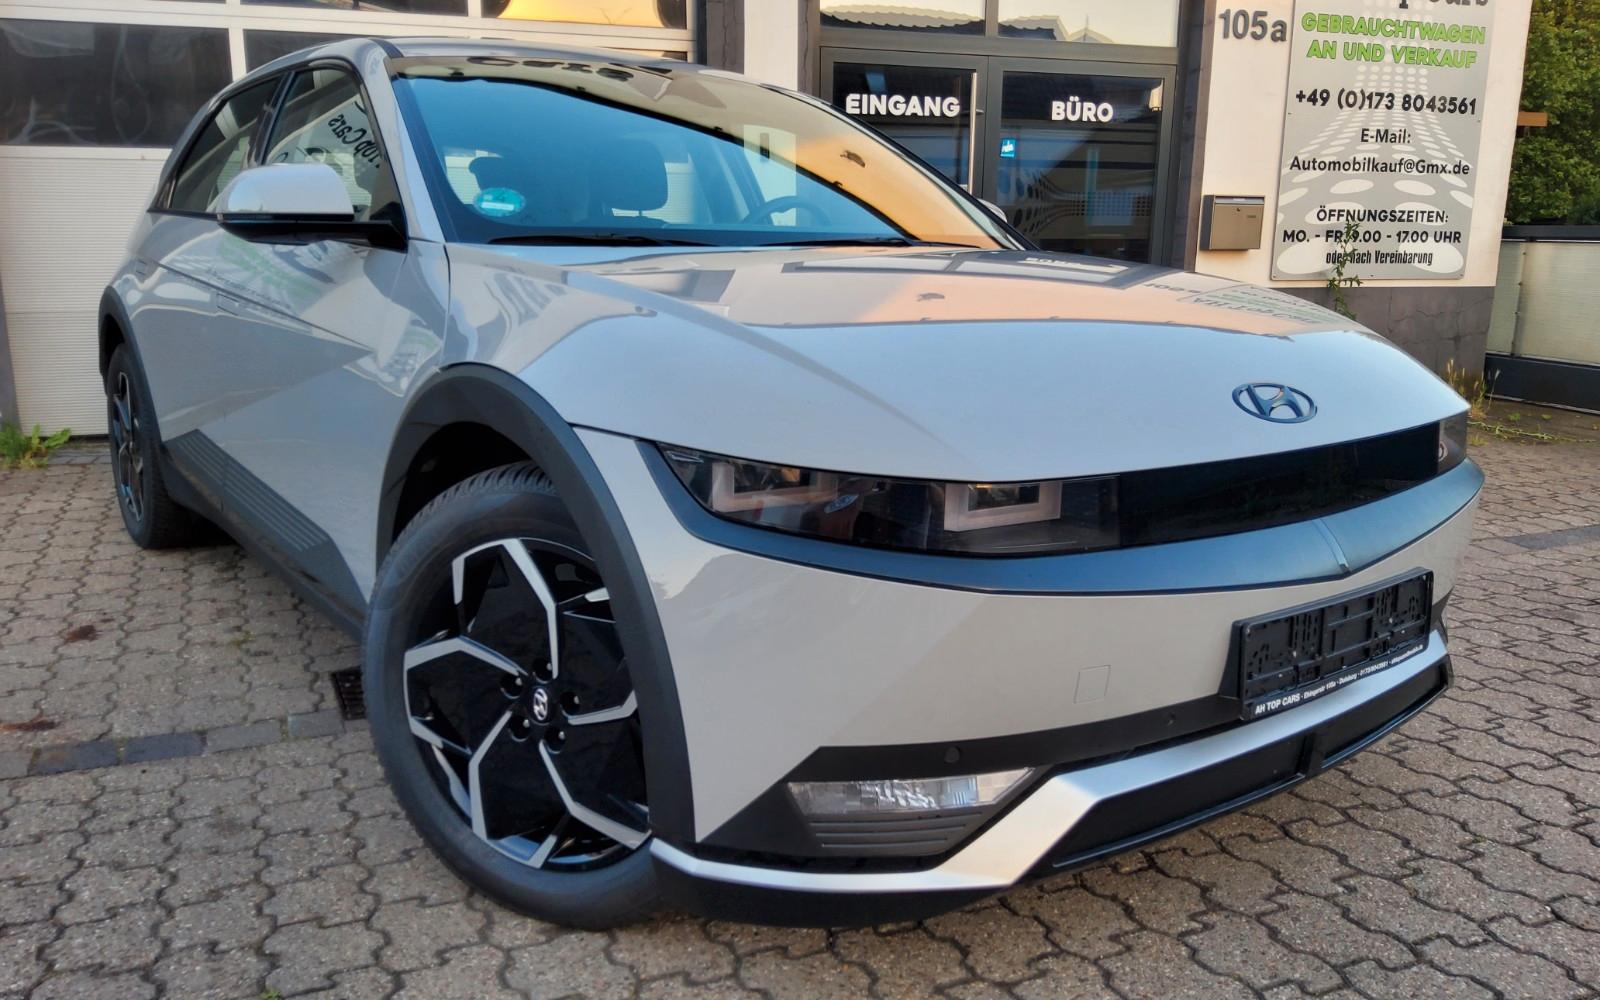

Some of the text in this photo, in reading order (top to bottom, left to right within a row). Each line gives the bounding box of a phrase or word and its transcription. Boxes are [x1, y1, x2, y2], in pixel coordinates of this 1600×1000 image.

[1219, 8, 1288, 42] 105a
[1301, 12, 1486, 45] GEBRAUCHTWAGEN
[1306, 40, 1478, 69] AN UND VERKAUF
[845, 93, 961, 119] EINGANG
[1051, 96, 1114, 123] BÜRO
[1296, 89, 1331, 108] +49
[1401, 94, 1477, 116] 8043561
[1360, 128, 1412, 145] E-Mail:
[1289, 156, 1471, 176] Automobilkauf@Gmx.de
[1316, 205, 1449, 224] ÖFFNUNGSZEITEN:
[1282, 230, 1310, 243] MO.
[1351, 230, 1382, 243] 9.00
[1395, 230, 1430, 244] 17.00
[1433, 230, 1462, 245] UHR
[1325, 250, 1346, 264] ode
[1374, 250, 1434, 267] Vereinbarung
[1255, 703, 1266, 715] AH
[1266, 698, 1281, 711] TOP
[1282, 693, 1300, 706] CARS
